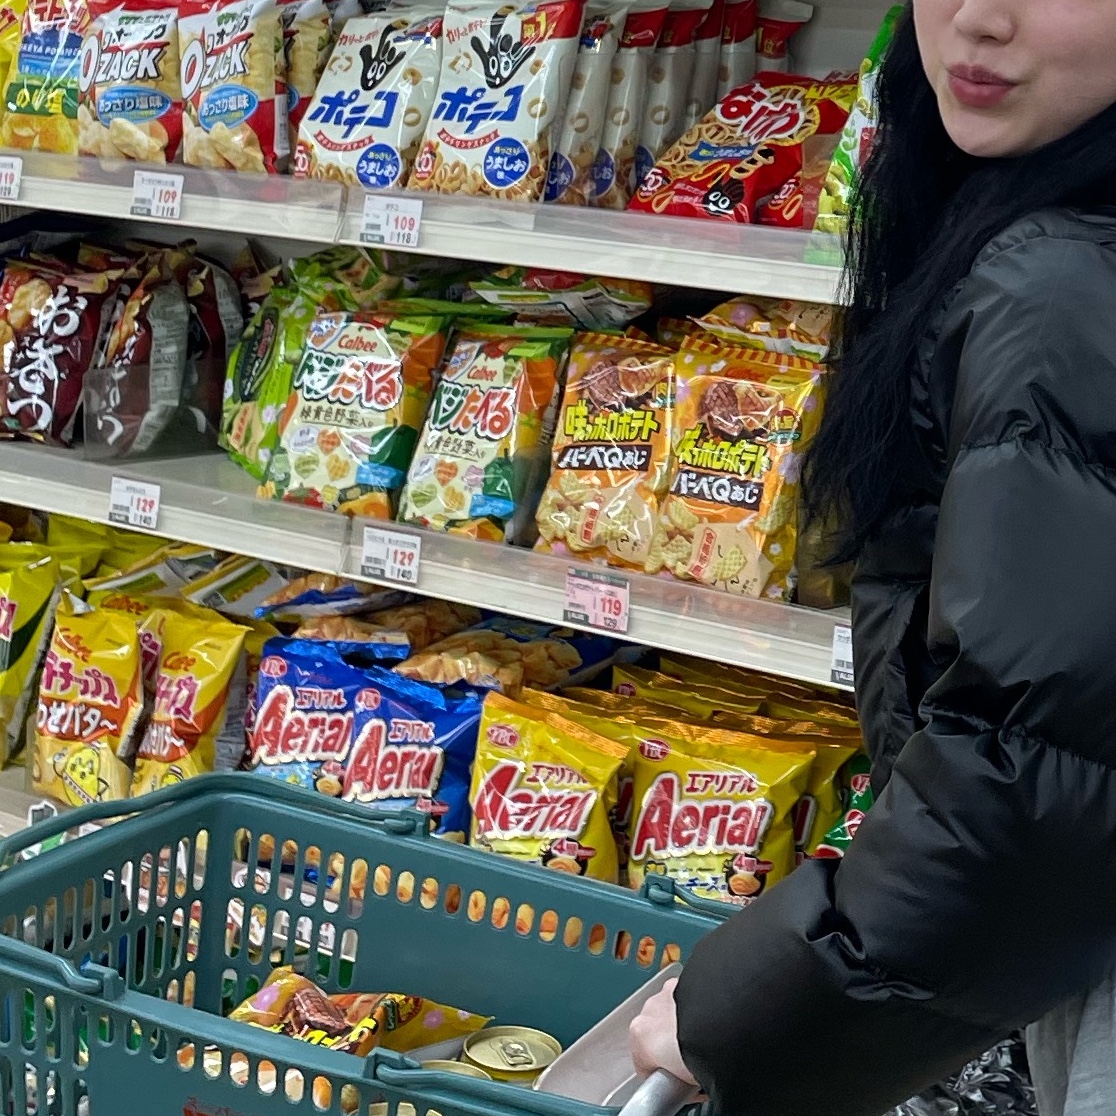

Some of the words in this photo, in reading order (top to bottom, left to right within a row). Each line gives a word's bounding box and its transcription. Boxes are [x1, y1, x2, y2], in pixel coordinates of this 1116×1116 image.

[308, 90, 399, 139] ポテコ
[433, 85, 525, 134] ポテコ
[485, 157, 528, 173] うましお
[156, 188, 178, 204] 109
[393, 214, 416, 231] 109
[337, 334, 378, 352] Calbee
[466, 364, 498, 383] Calbee
[671, 473, 761, 505] バーベQあじ
[135, 498, 155, 513] 129
[392, 550, 414, 567] 129
[600, 597, 622, 616] 119
[251, 684, 355, 764] Aerial
[684, 772, 758, 794] エアリアル
[632, 772, 774, 860] Aerial
